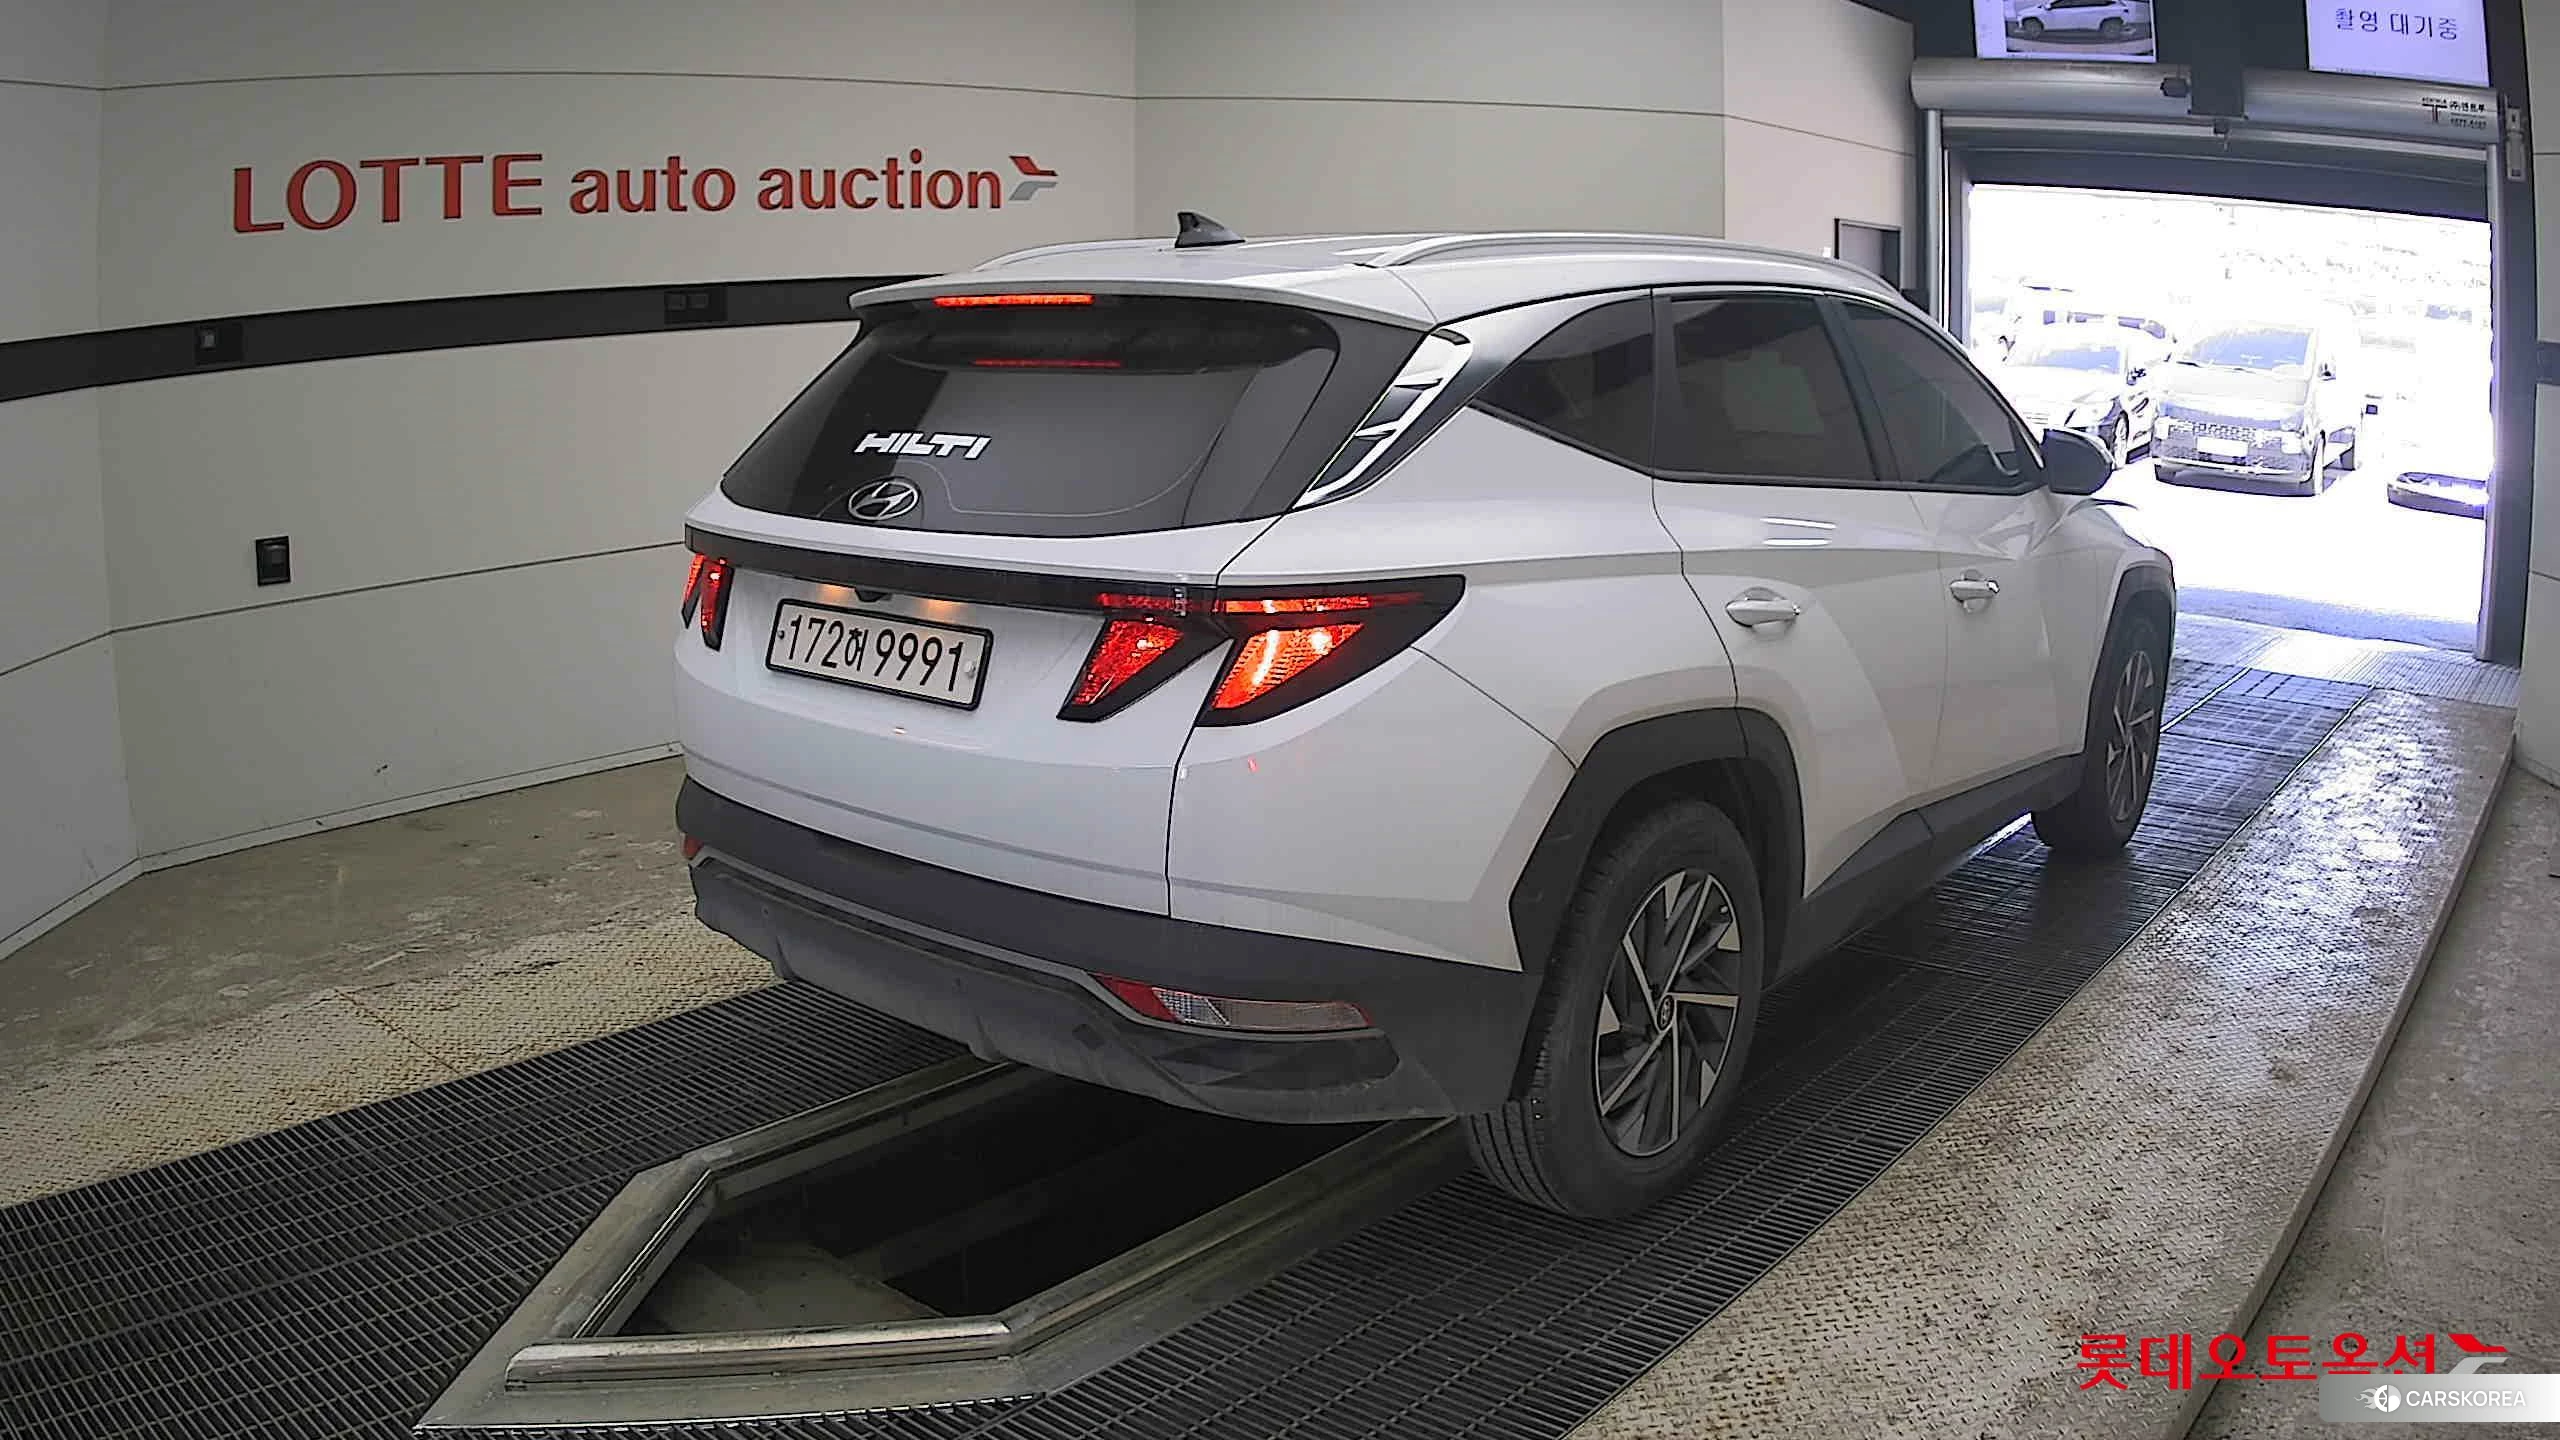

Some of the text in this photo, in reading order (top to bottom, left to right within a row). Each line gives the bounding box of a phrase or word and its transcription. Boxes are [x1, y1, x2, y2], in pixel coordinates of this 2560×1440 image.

[2335, 7, 2379, 33] 촬영
[234, 148, 1003, 233] LOTTE auto auction
[854, 432, 992, 459] HILTI
